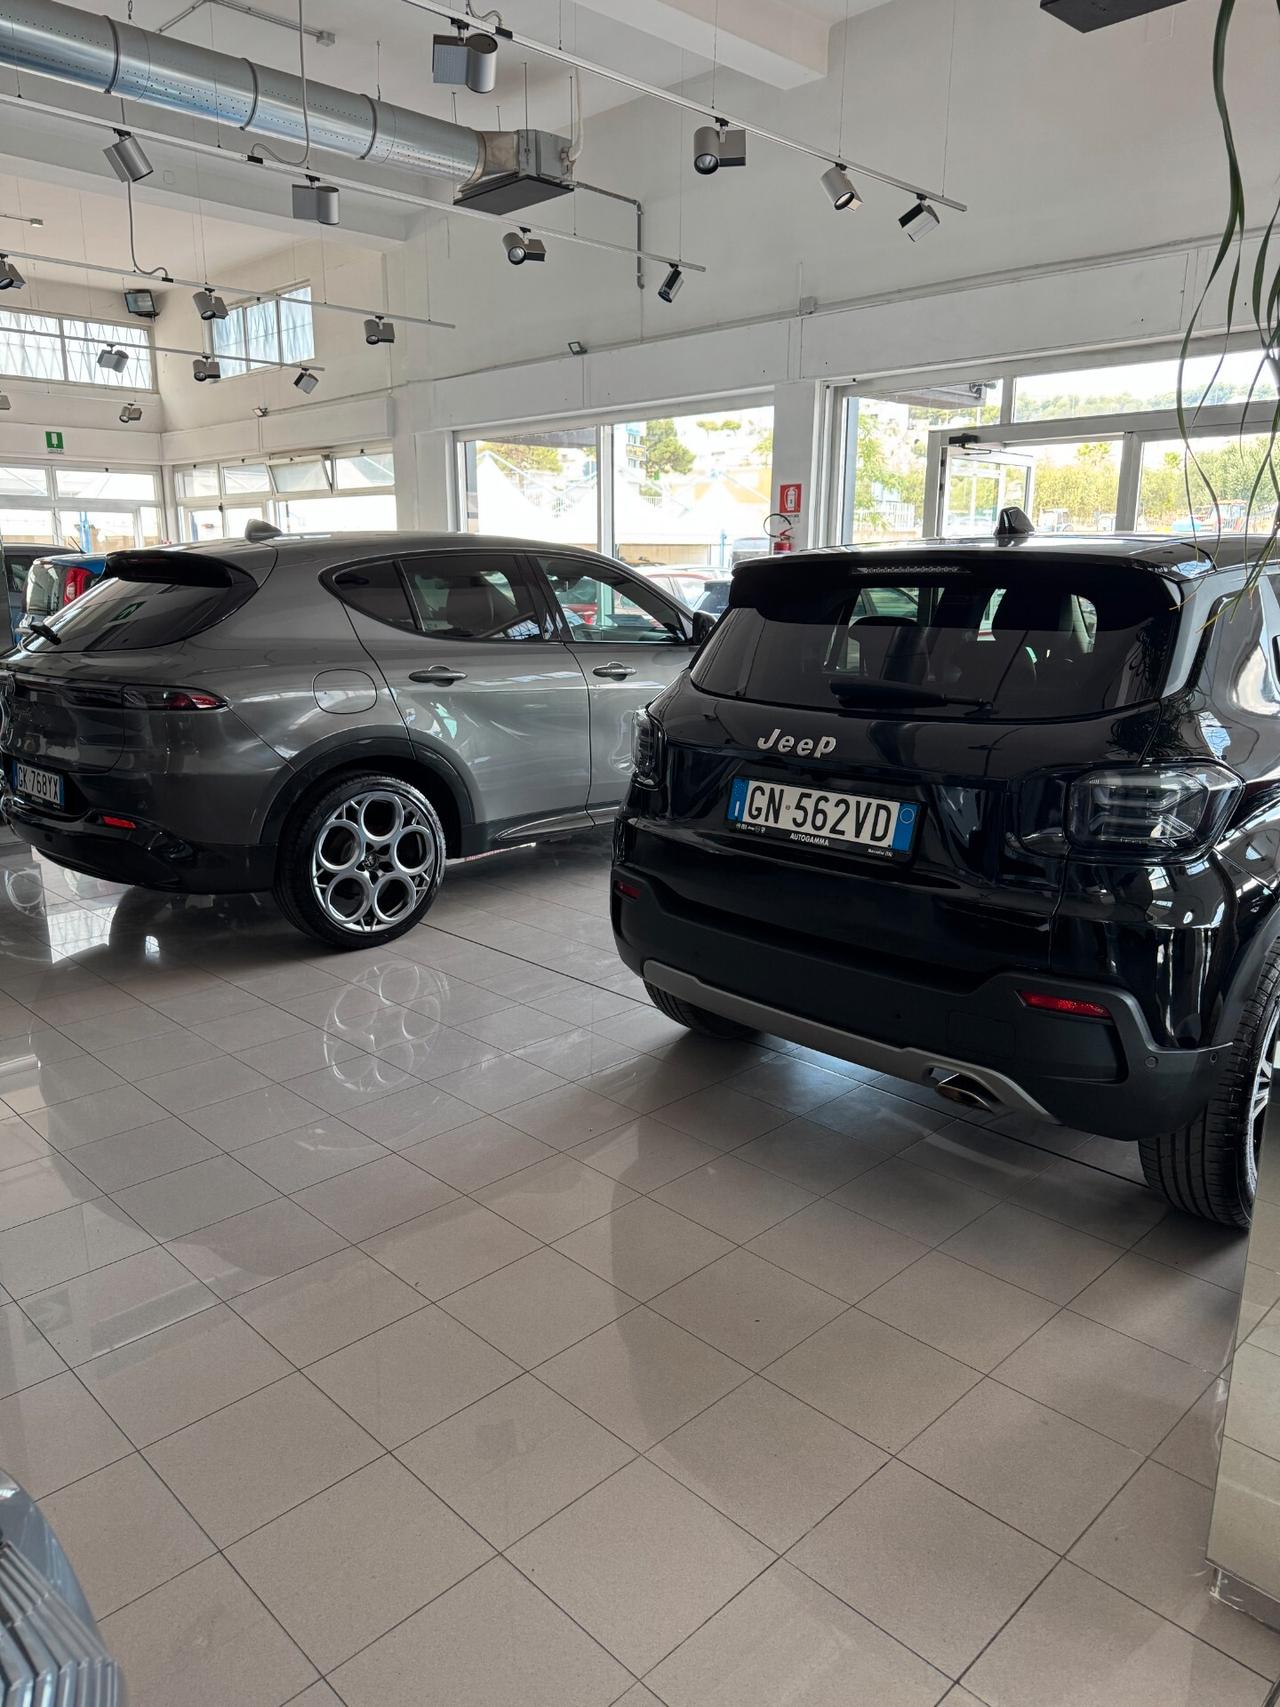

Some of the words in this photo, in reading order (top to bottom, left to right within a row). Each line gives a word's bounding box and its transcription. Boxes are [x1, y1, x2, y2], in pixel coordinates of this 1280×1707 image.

[757, 728, 837, 759] Jeep
[31, 770, 59, 801] 768YX
[747, 785, 785, 824] GN
[792, 792, 892, 842] 562VD
[790, 832, 829, 847] AUTOGAMMA
